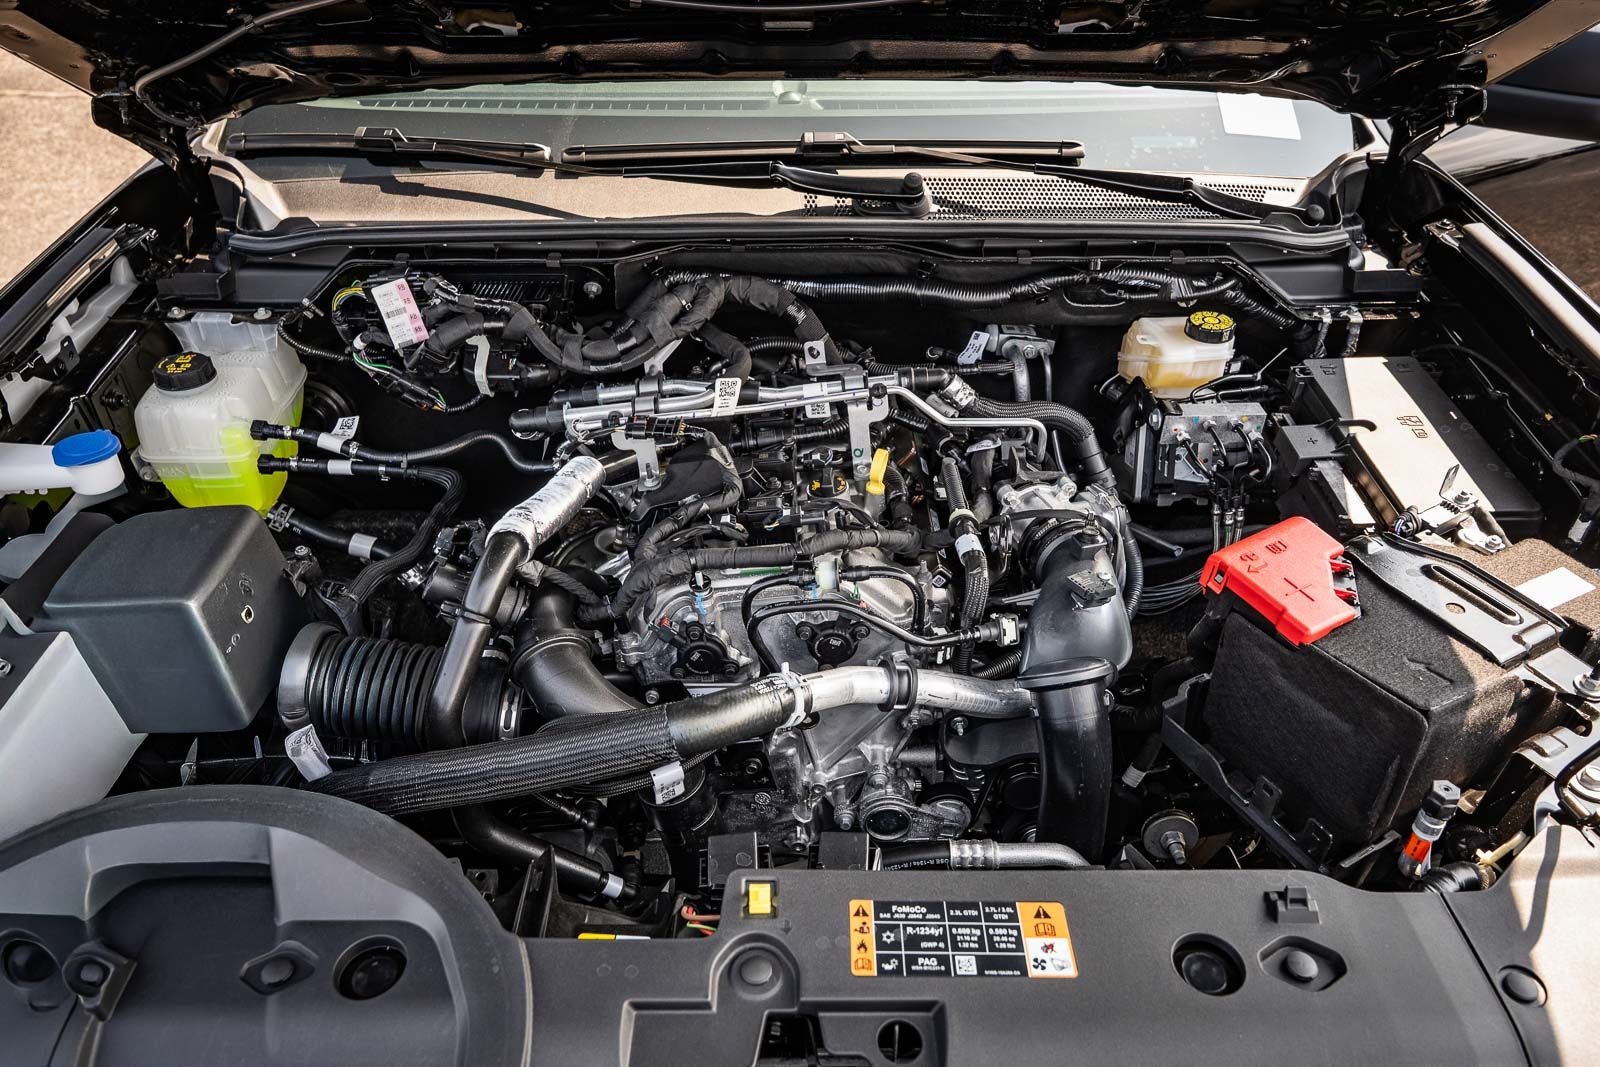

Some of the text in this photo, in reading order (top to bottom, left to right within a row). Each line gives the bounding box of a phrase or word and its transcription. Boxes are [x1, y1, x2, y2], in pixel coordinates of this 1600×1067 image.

[891, 905, 927, 914] FoMoCo
[906, 926, 943, 936] R-1234yf
[952, 927, 981, 936] 0.600 kg
[1008, 928, 1018, 936] kg
[917, 957, 938, 966] PAG
